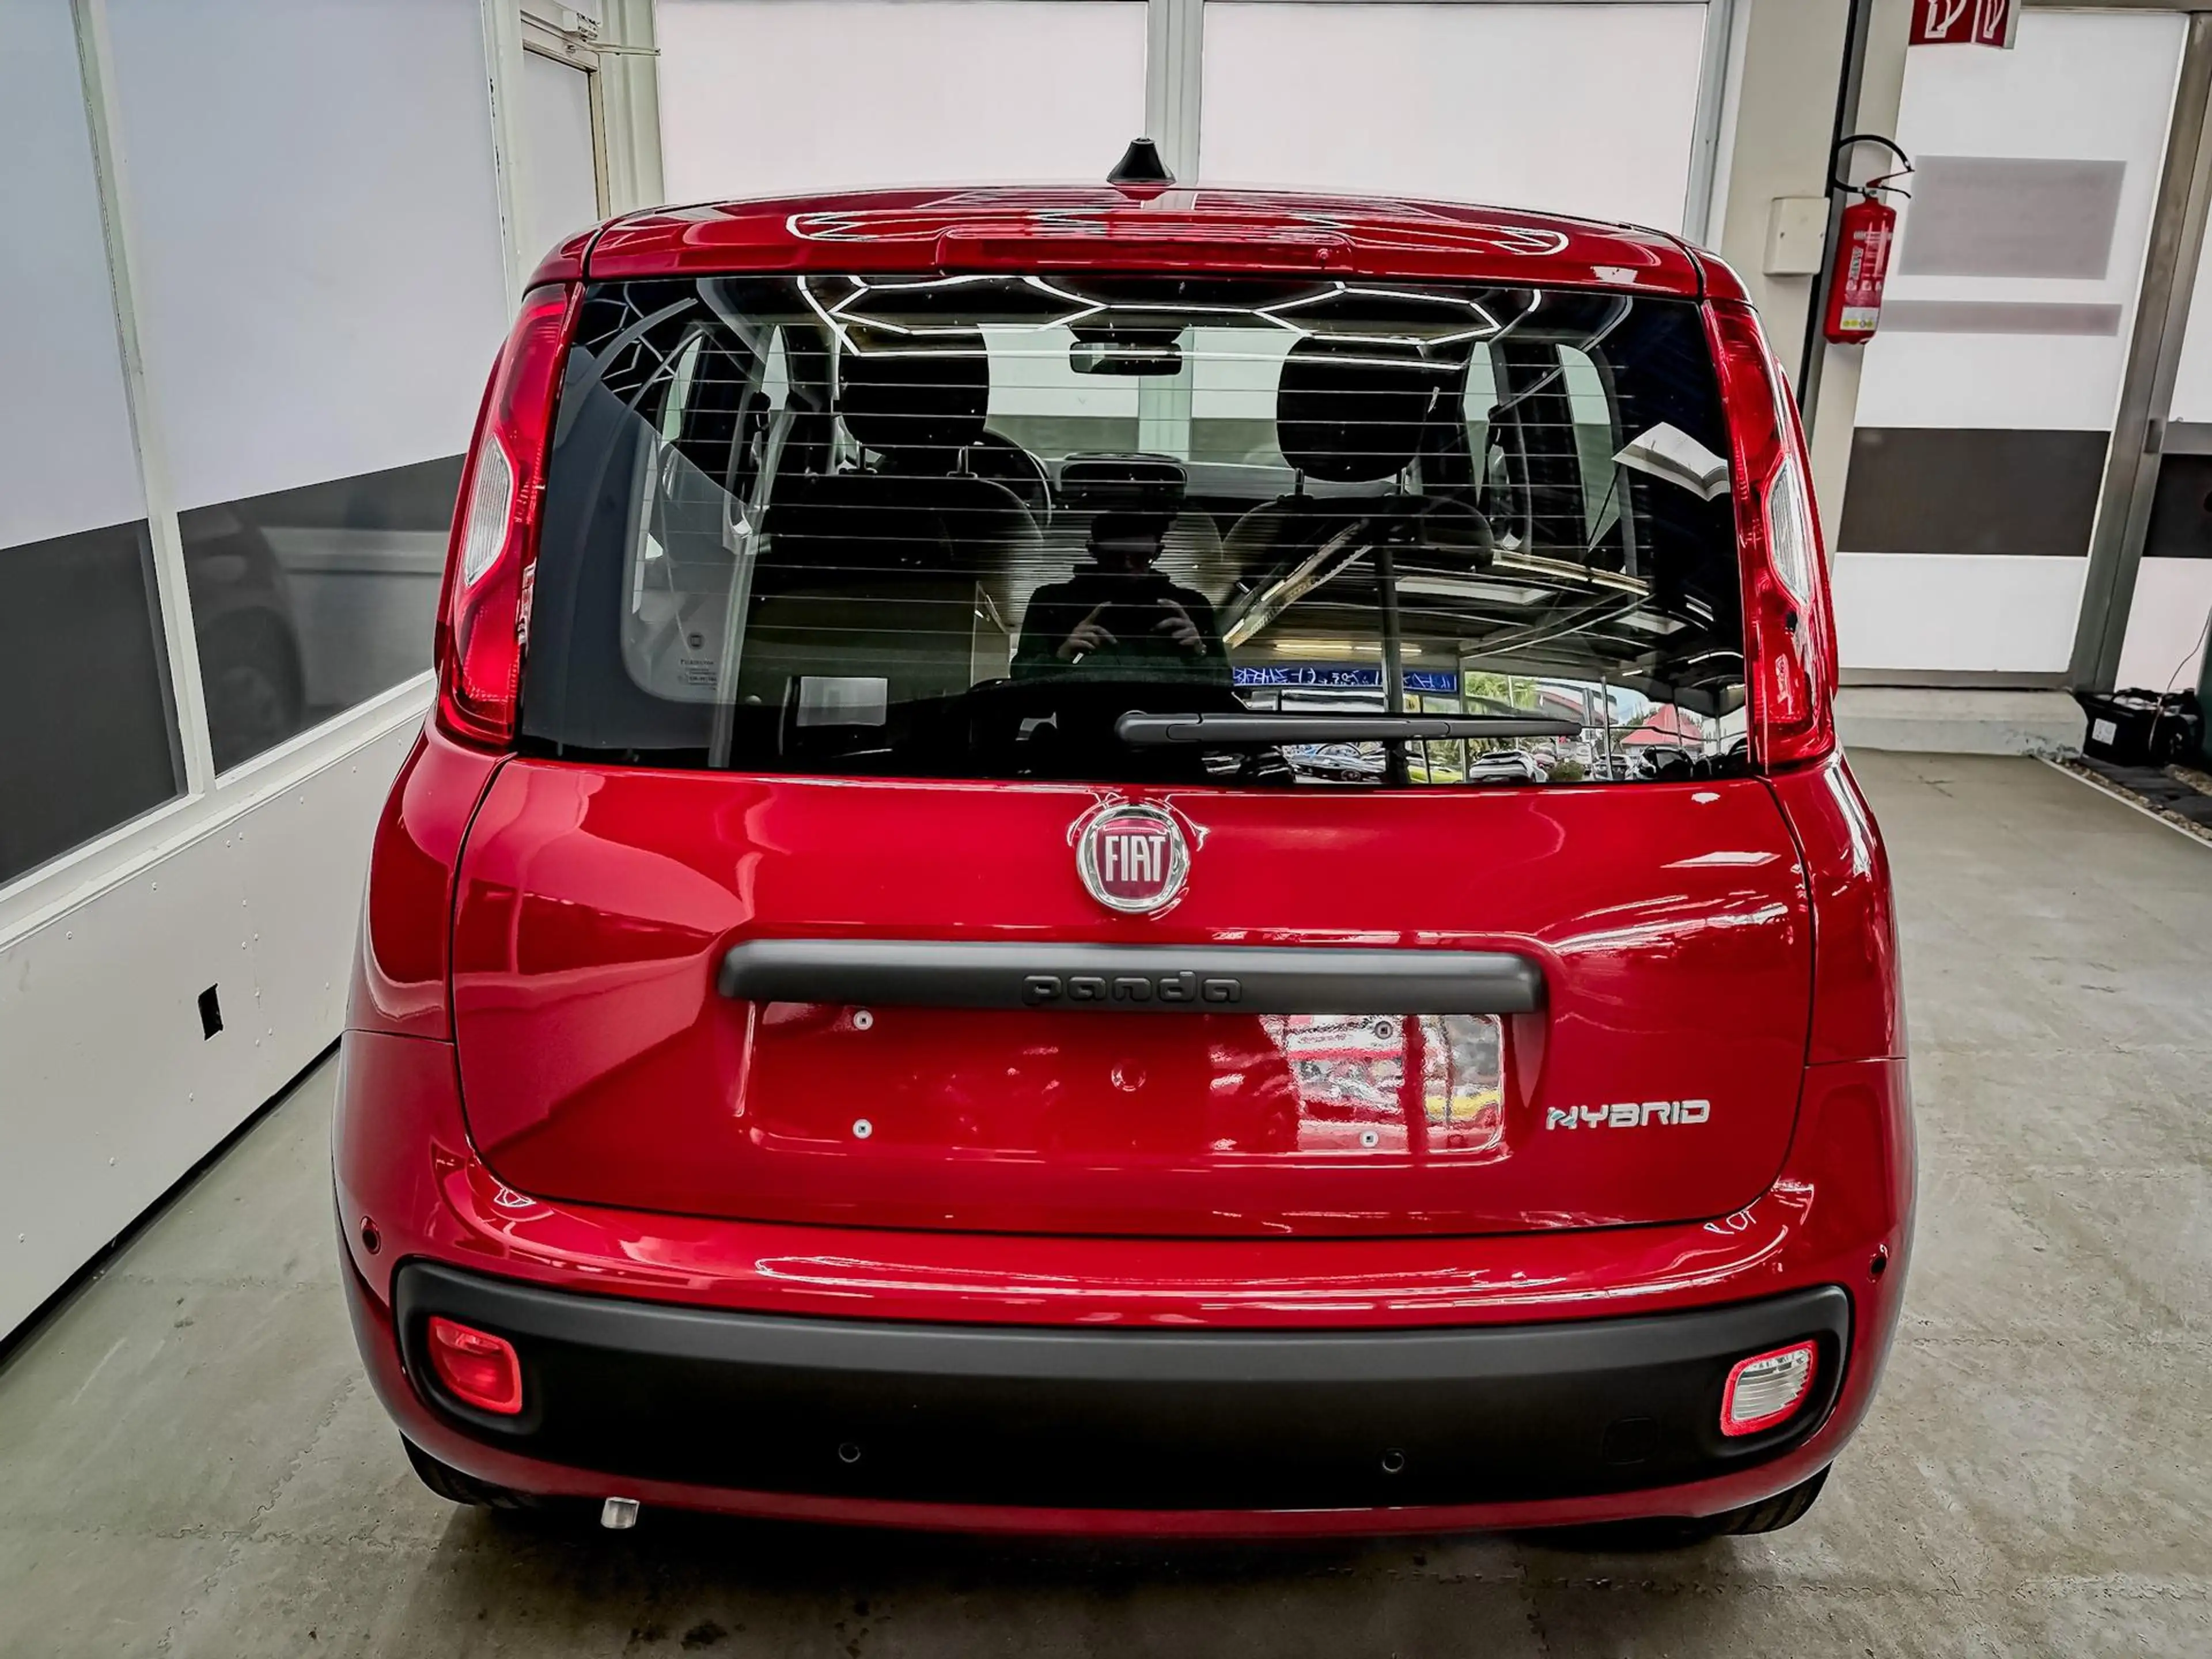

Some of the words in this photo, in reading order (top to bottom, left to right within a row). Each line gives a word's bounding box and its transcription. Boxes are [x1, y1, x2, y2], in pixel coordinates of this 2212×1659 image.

[1105, 835, 1166, 882] FIAT
[1022, 969, 1242, 1005] panda
[1546, 1099, 1711, 1130] HYBRID
